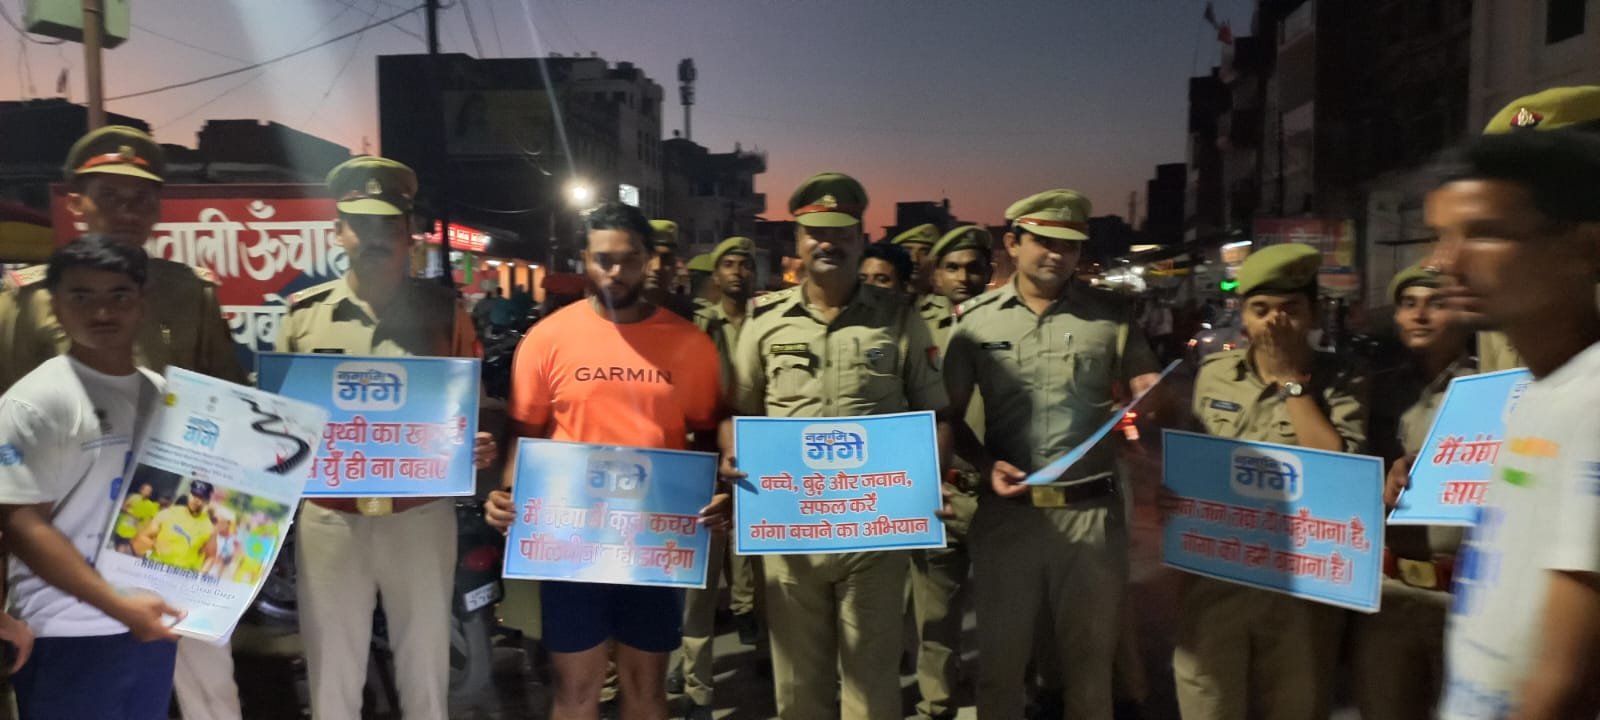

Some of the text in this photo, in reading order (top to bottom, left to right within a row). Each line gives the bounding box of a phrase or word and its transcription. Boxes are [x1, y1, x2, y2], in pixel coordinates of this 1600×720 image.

[575, 366, 673, 384] GARMIN
[372, 423, 401, 444] का
[345, 451, 367, 480] ही
[371, 457, 395, 479] ना
[760, 473, 798, 492] बच्चे,
[829, 471, 859, 490] और
[861, 471, 912, 489] जवान,
[799, 493, 877, 515] सफल करें
[750, 516, 929, 539] गंगा बचाने का अभियान
